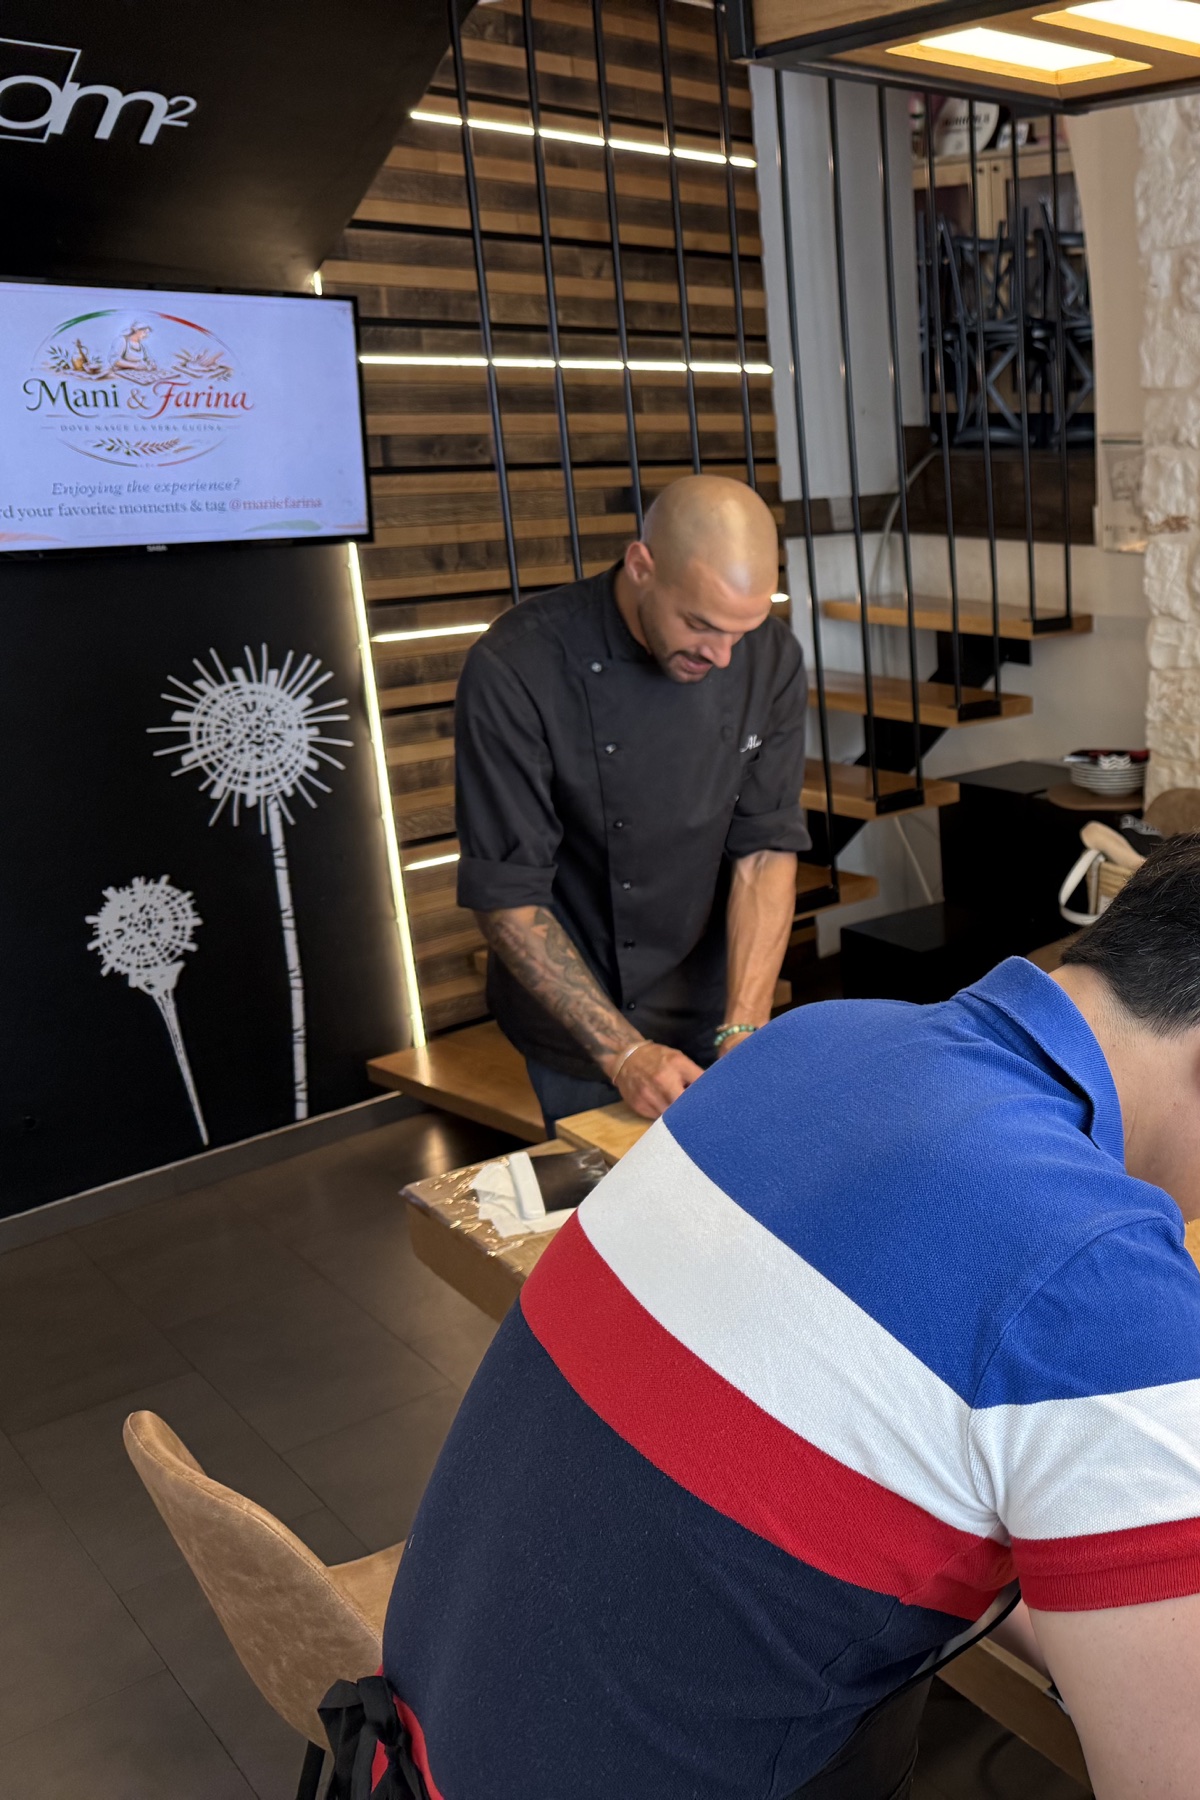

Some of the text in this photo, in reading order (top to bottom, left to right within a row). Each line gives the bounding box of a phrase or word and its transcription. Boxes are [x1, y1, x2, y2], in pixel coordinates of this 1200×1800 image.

[23, 378, 255, 419] Mani & Farina
[52, 478, 240, 497] Enjoying the experience?
[17, 507, 53, 522] your
[58, 502, 116, 517] favorite
[119, 499, 187, 515] moments
[189, 499, 202, 512] &
[205, 500, 227, 514] tag
